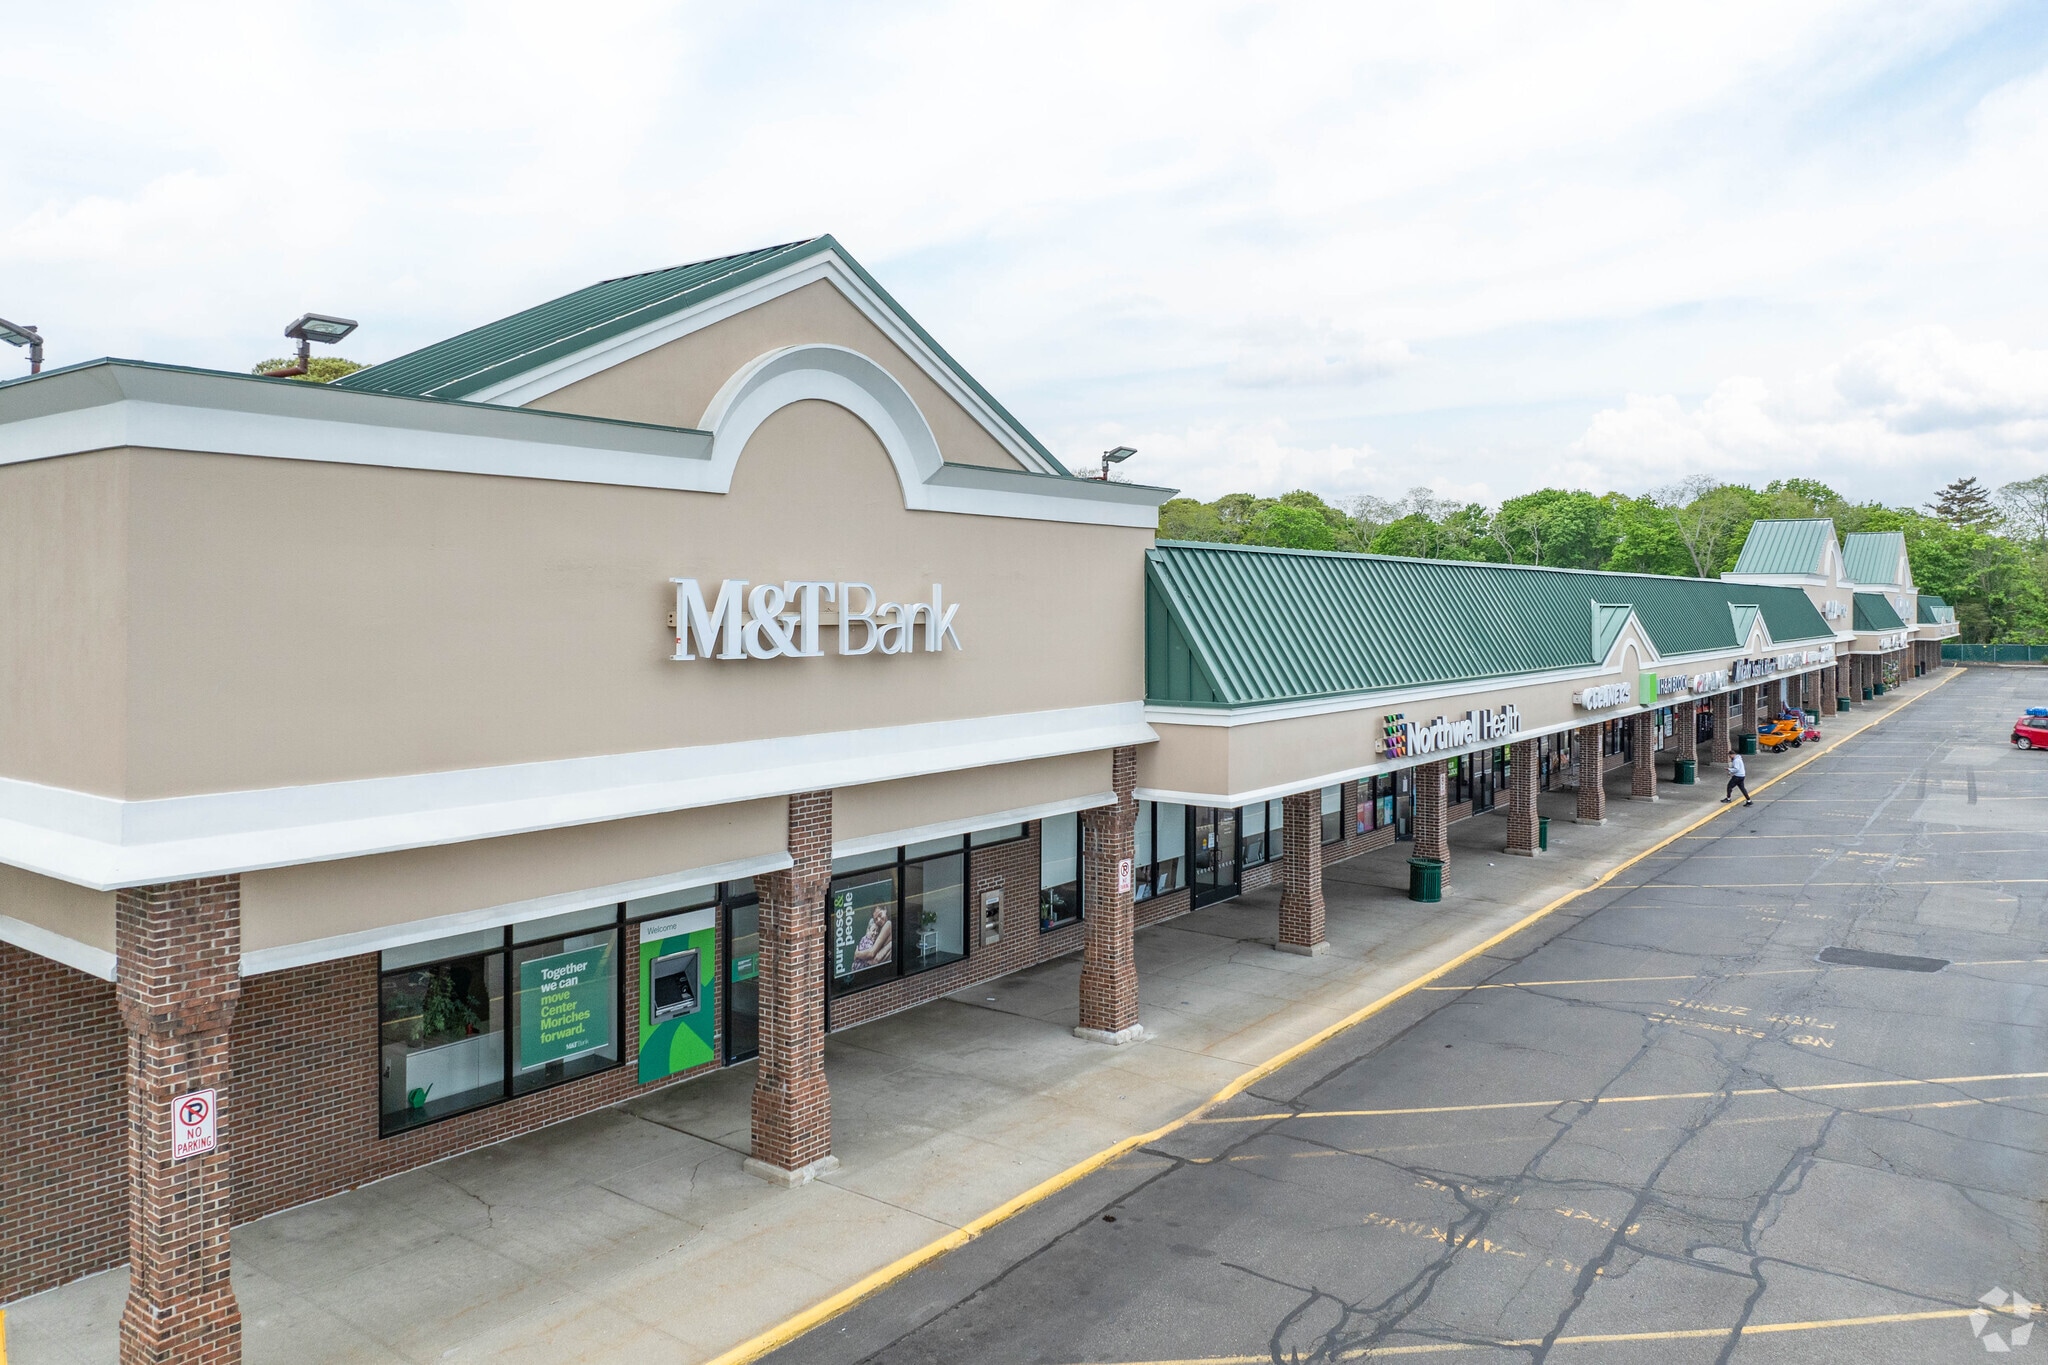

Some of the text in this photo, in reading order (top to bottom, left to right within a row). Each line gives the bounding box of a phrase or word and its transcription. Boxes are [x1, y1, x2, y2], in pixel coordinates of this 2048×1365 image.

[669, 577, 963, 661] M&T Bank
[1406, 704, 1521, 757] Northwell Health
[844, 892, 855, 946] people
[647, 923, 677, 935] Welcome
[835, 908, 846, 974] purpose
[541, 962, 588, 980] Together
[541, 976, 578, 993] we can
[541, 990, 570, 1005] move
[541, 1001, 577, 1017] Center
[541, 1009, 590, 1030] Moriches
[540, 1023, 585, 1044] forward.
[187, 1127, 203, 1139] NO
[177, 1136, 212, 1155] PARKING
